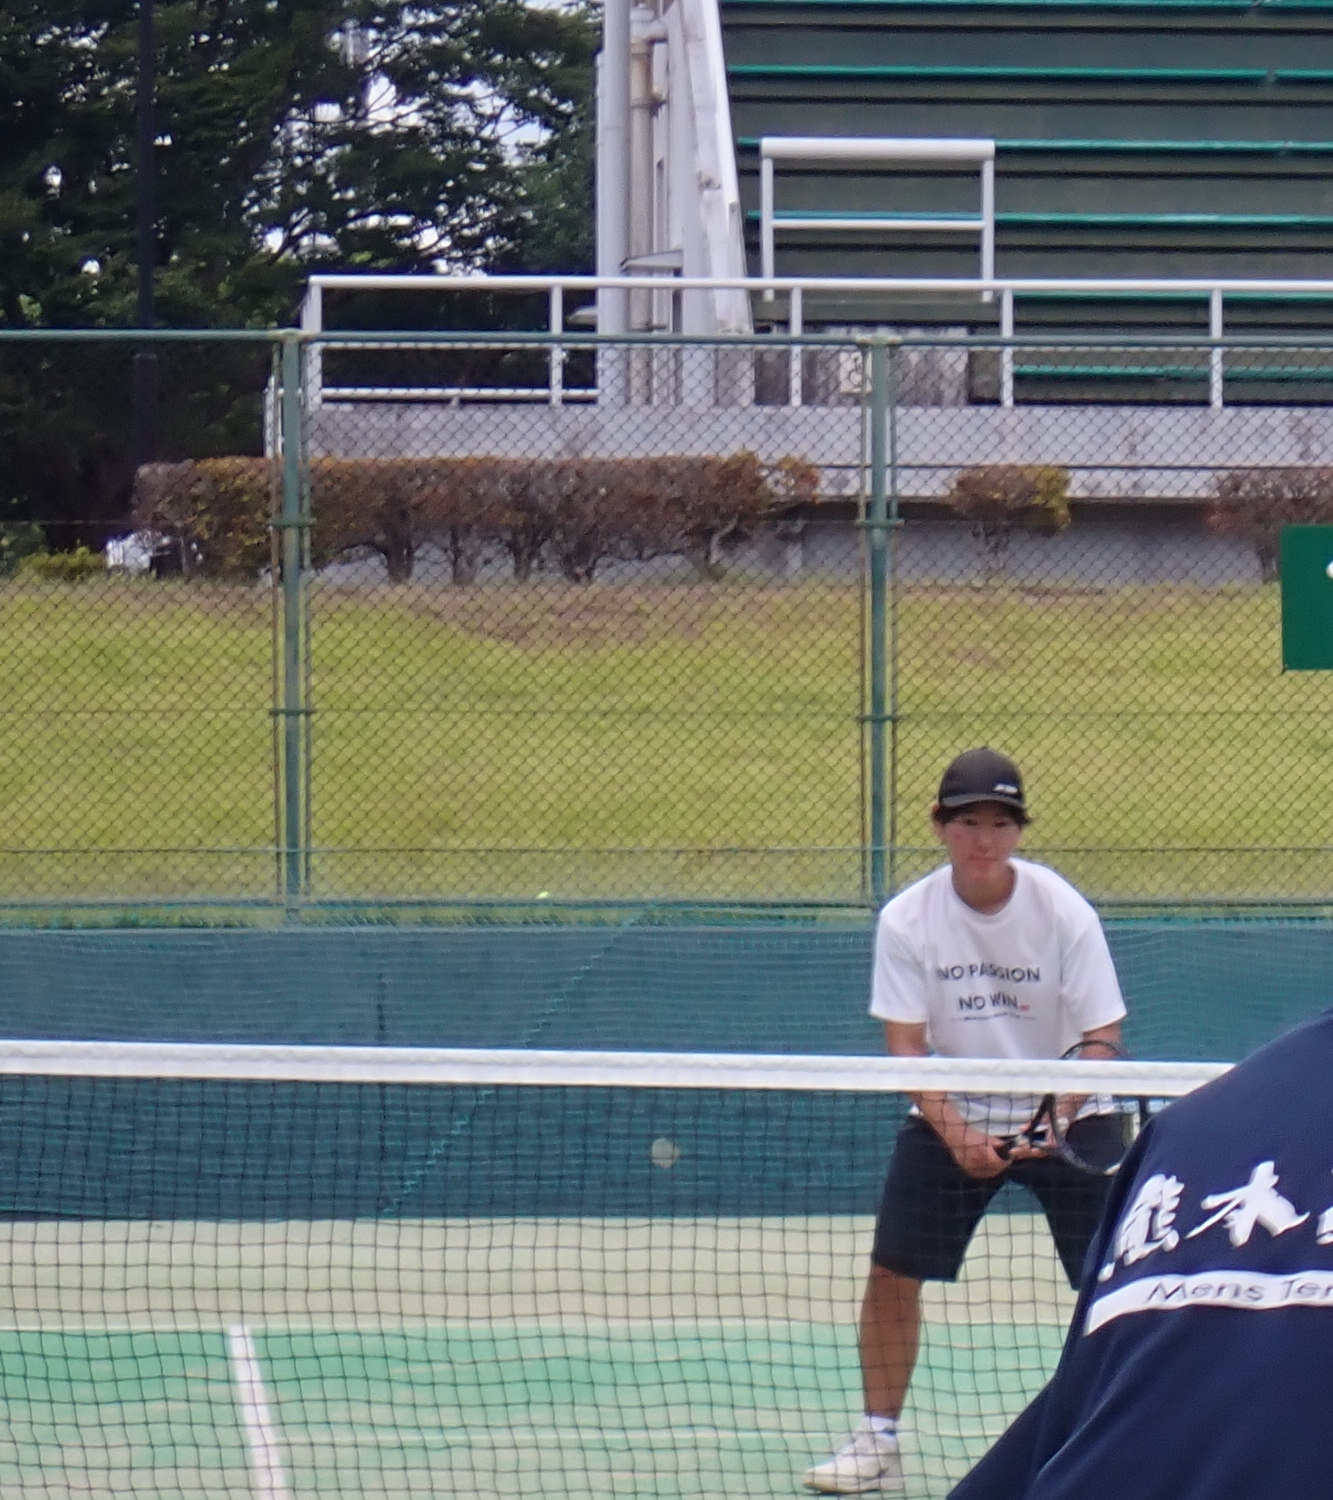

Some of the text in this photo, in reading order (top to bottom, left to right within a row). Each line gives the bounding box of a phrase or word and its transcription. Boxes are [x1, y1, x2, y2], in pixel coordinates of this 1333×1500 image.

[936, 963, 1041, 983] NO PASSION
[958, 995, 985, 1010] NO
[1146, 1279, 1265, 1304] Mens
